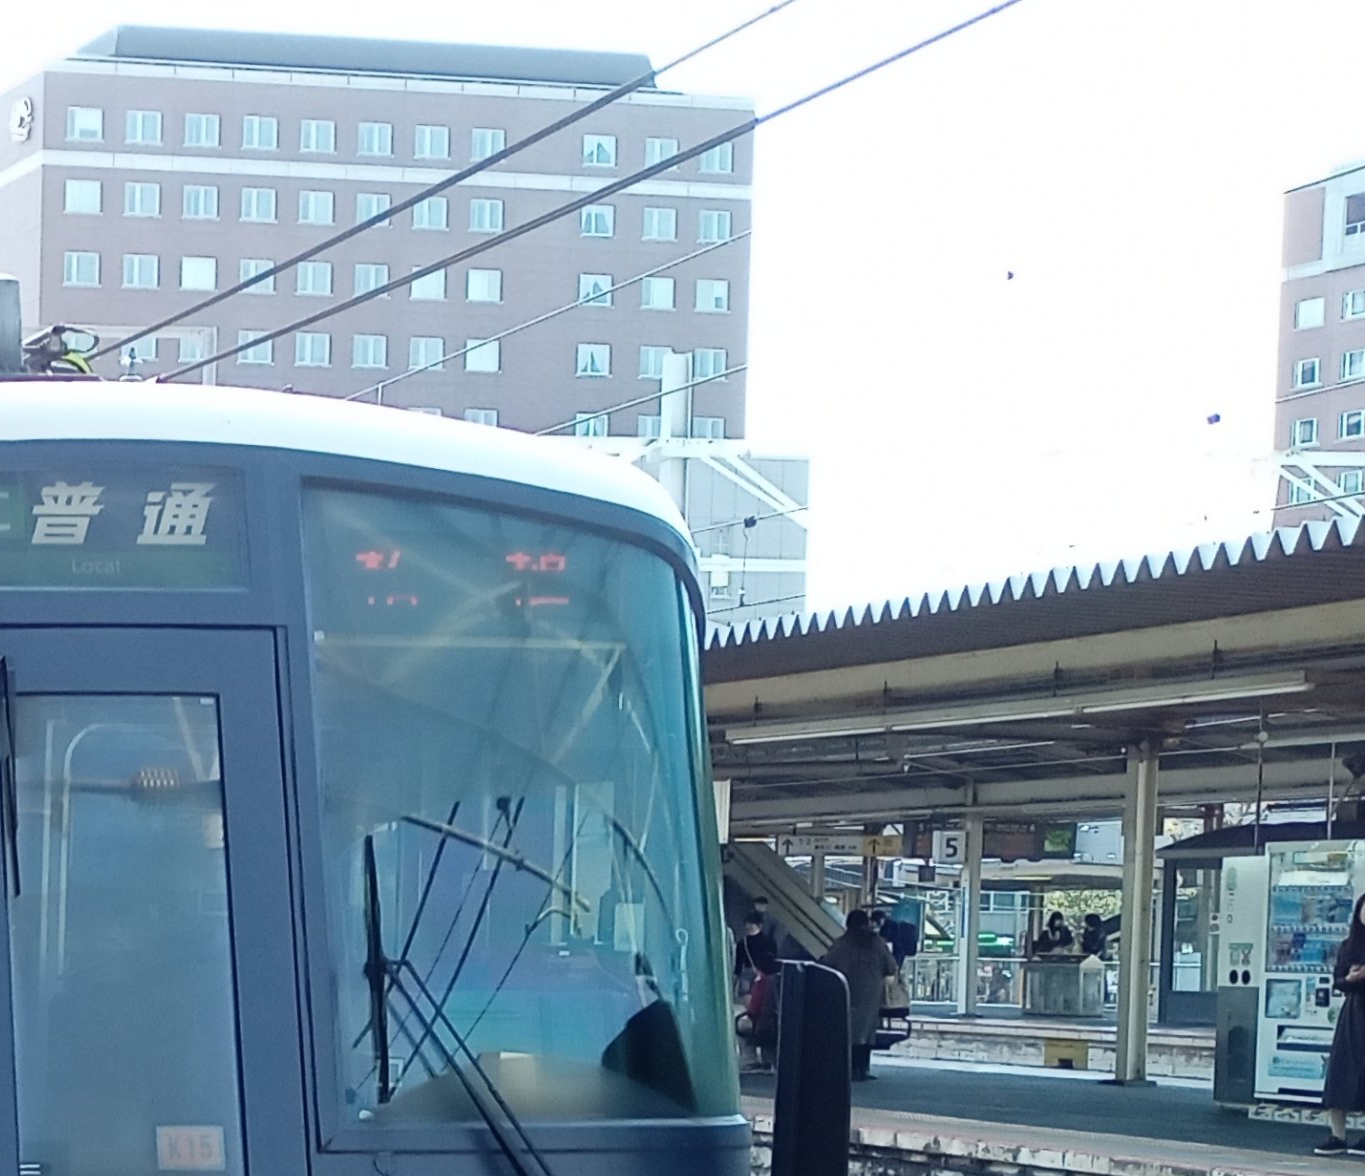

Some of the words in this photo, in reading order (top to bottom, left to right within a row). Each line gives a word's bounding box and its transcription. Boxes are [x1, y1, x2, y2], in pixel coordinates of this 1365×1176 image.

[31, 481, 216, 545] 普通
[71, 559, 122, 574] Local
[945, 837, 958, 858] 5
